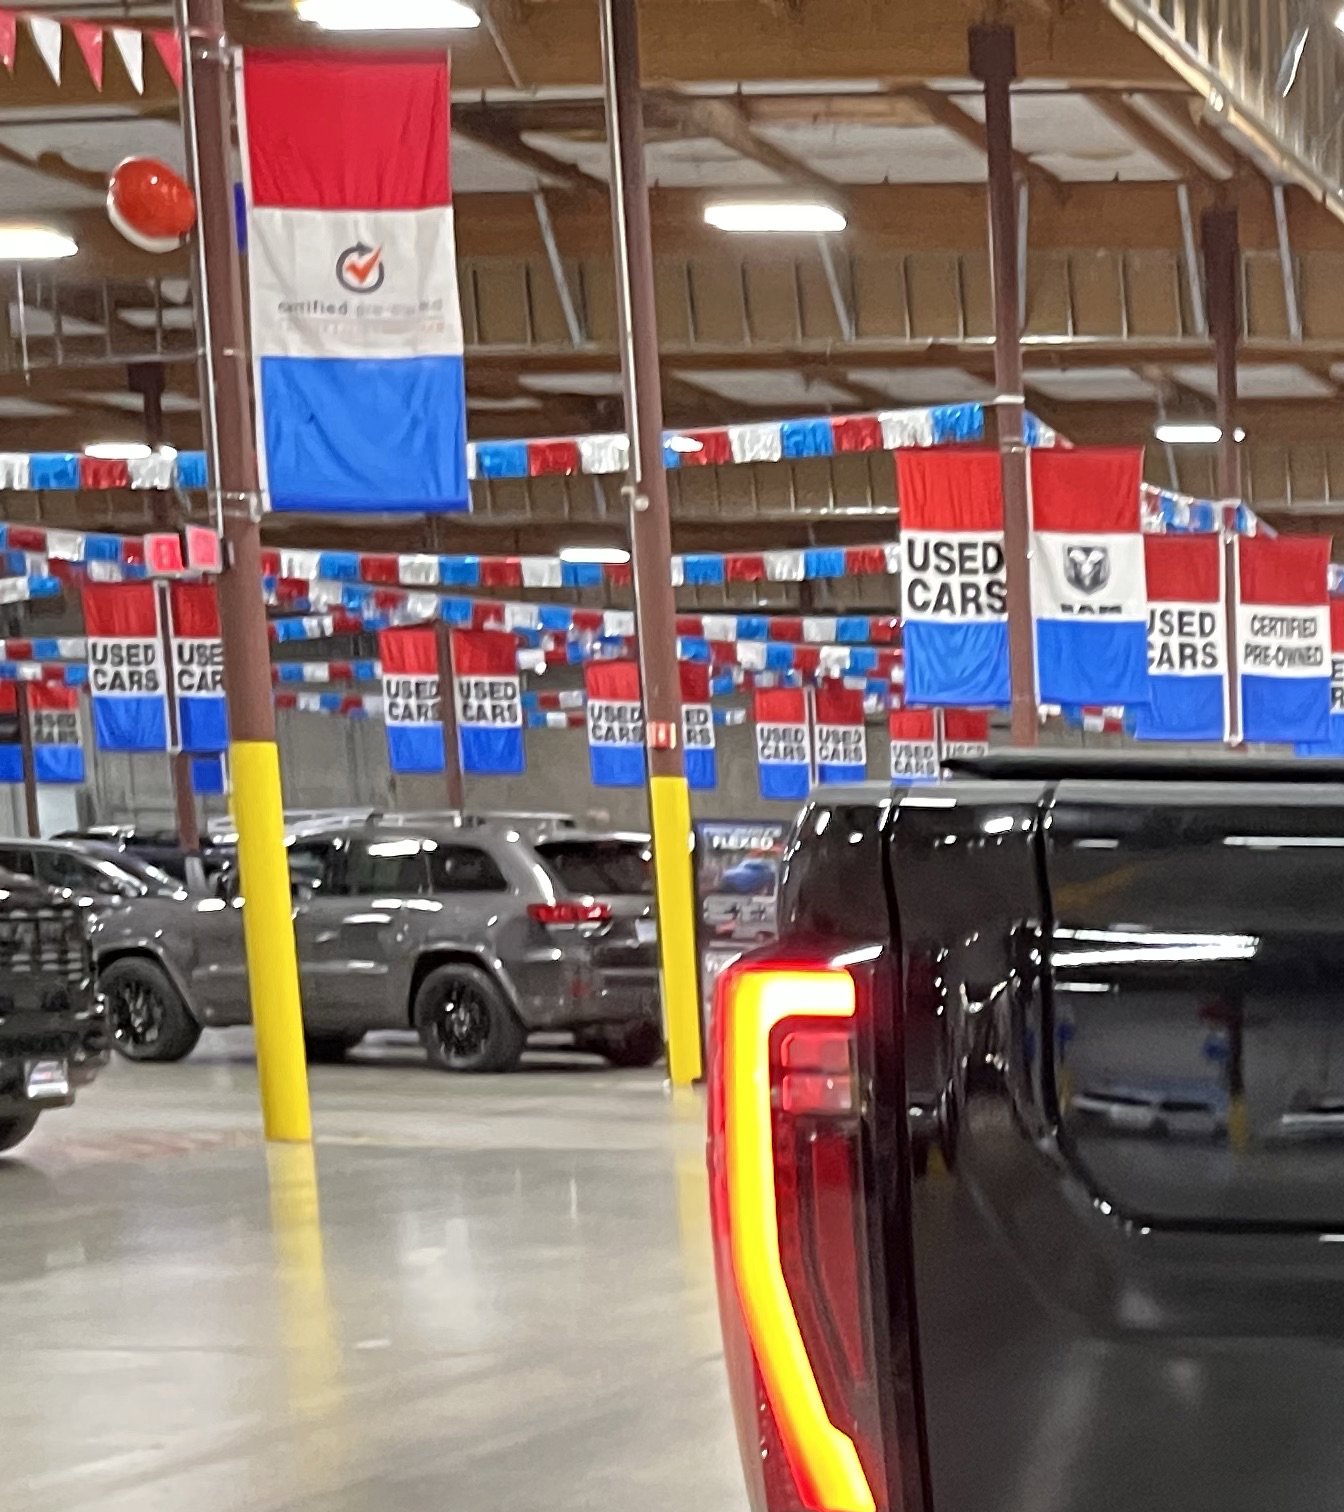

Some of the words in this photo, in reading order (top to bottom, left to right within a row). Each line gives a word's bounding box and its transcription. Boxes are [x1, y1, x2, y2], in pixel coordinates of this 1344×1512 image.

[907, 538, 1004, 576] USED
[907, 578, 1007, 615] CARS
[1250, 614, 1318, 639] CERTIFIED
[90, 642, 156, 667] USED
[177, 643, 223, 666] USE
[1243, 642, 1324, 668] PRE-OWNED
[92, 668, 160, 692] CARS
[177, 668, 223, 692] CAR
[386, 679, 439, 700] USED
[459, 680, 517, 700] USED
[462, 701, 518, 722] CARS
[591, 704, 642, 724] USED
[685, 708, 709, 726] ED
[687, 727, 711, 746] RS
[760, 727, 805, 743] USED
[818, 728, 863, 745] USED
[761, 744, 806, 762] CARS
[818, 744, 863, 762] CARS
